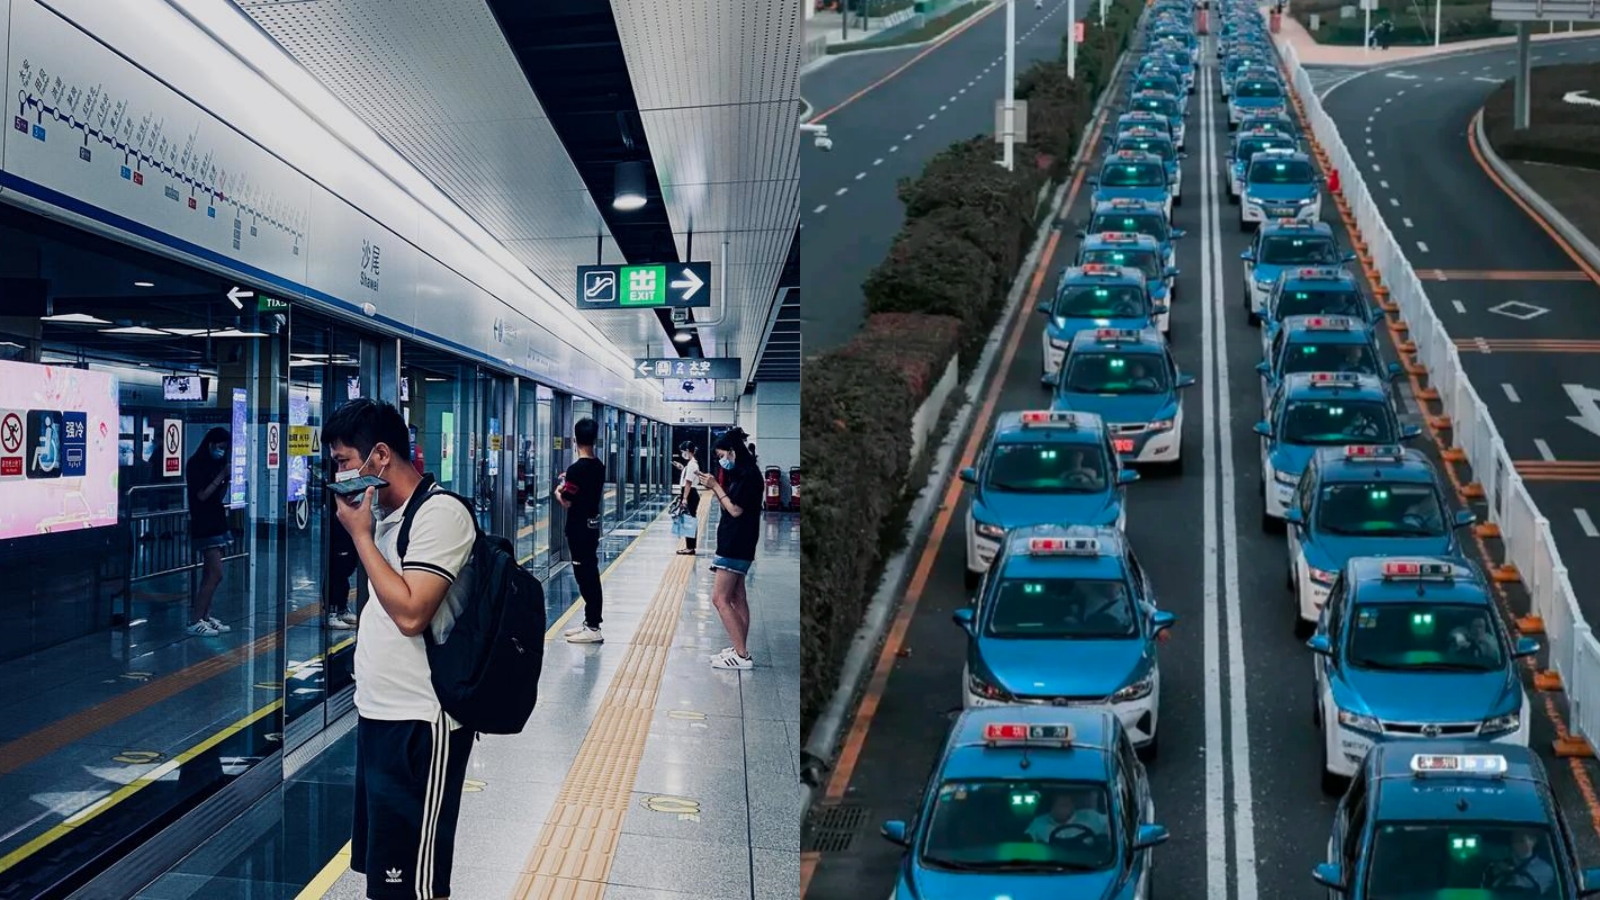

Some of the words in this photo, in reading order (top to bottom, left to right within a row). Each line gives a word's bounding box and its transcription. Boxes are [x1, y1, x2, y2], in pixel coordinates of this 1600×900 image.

[361, 239, 380, 276] 沙尾
[360, 271, 379, 292] Shawei
[630, 291, 656, 301] EXIT
[676, 362, 684, 371] 2
[690, 361, 711, 371] 太安
[65, 421, 84, 438] 强冷
